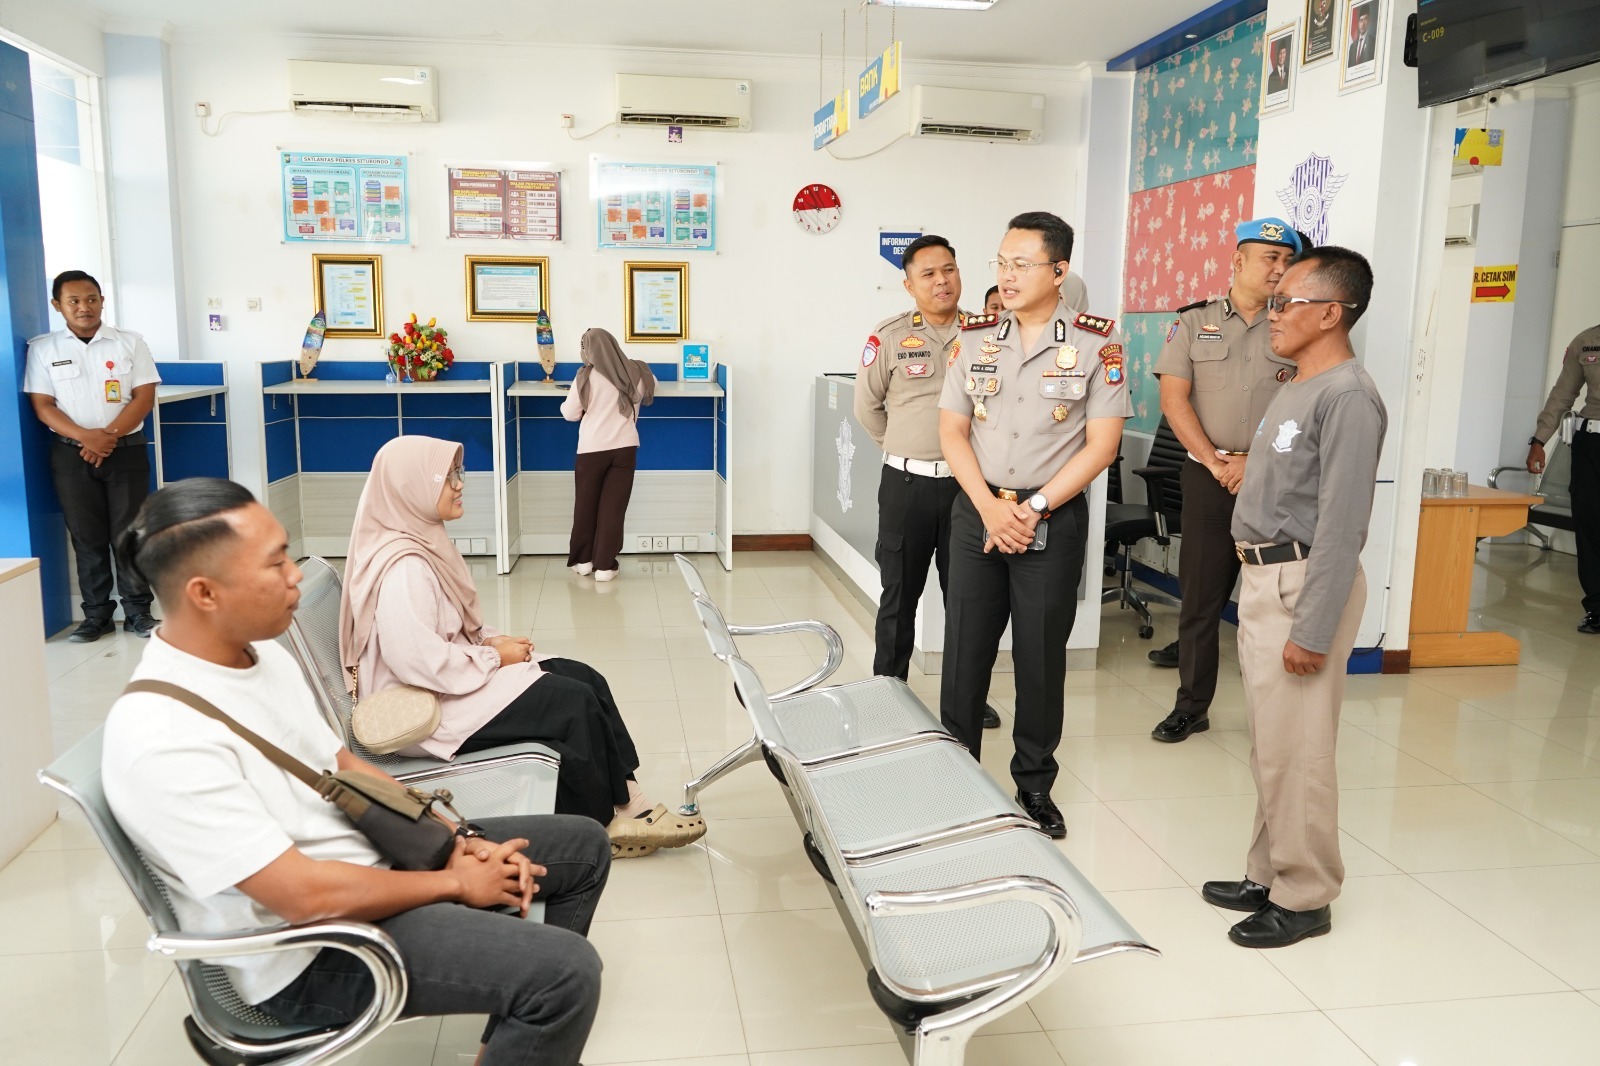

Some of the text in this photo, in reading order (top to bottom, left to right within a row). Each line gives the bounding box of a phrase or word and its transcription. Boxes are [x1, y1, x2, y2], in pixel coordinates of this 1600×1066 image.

[1423, 27, 1444, 42] C-009
[881, 237, 918, 246] INFORMATI
[893, 246, 906, 255] DES
[1474, 271, 1515, 282] R. CETAK SIM
